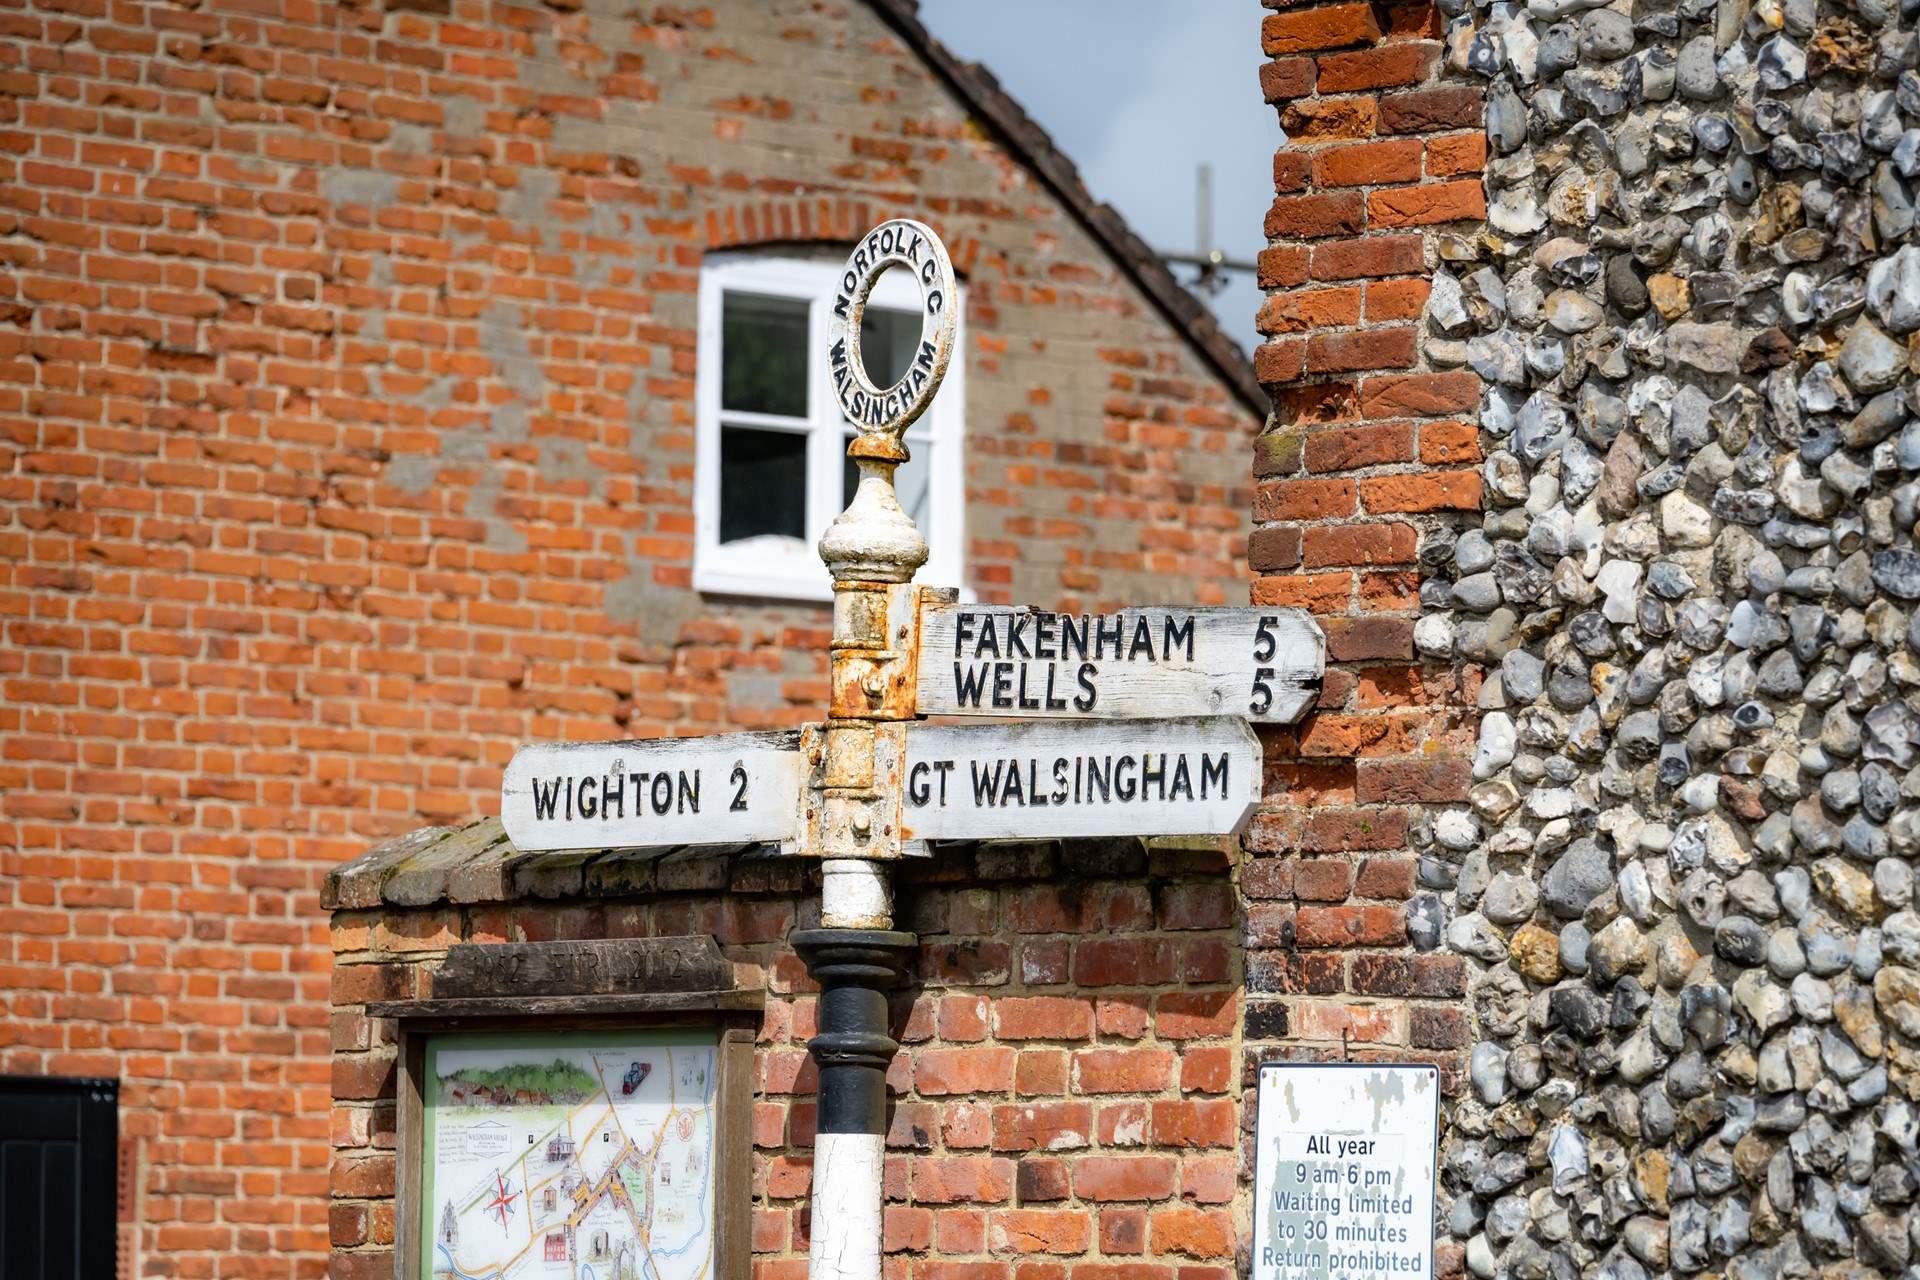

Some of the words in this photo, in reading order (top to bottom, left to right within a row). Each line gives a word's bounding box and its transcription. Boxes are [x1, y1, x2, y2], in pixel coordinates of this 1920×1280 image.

[834, 227, 922, 319] NORFOLK
[921, 259, 936, 284] C
[927, 290, 943, 315] C
[830, 337, 937, 424] WALSINGHAM
[954, 612, 1196, 662] FAKENHAM
[1253, 616, 1279, 663] 5
[954, 662, 1099, 712] WELLS
[1249, 667, 1275, 714] 5
[909, 760, 955, 808] GT
[970, 752, 1230, 807] WALSINGHAM
[531, 769, 700, 821] WIGHTON
[729, 767, 749, 813] 2
[1306, 1135, 1330, 1155] All
[1338, 1140, 1376, 1158] year
[1296, 1163, 1307, 1184] 9
[1365, 1169, 1391, 1188] pm
[1274, 1191, 1341, 1215] Waiting
[1350, 1193, 1413, 1214] limited
[1278, 1219, 1296, 1239] to
[1304, 1220, 1328, 1240] 30
[1335, 1222, 1407, 1243] minutes
[1263, 1247, 1321, 1267] Return
[1329, 1250, 1422, 1273] prohibited
